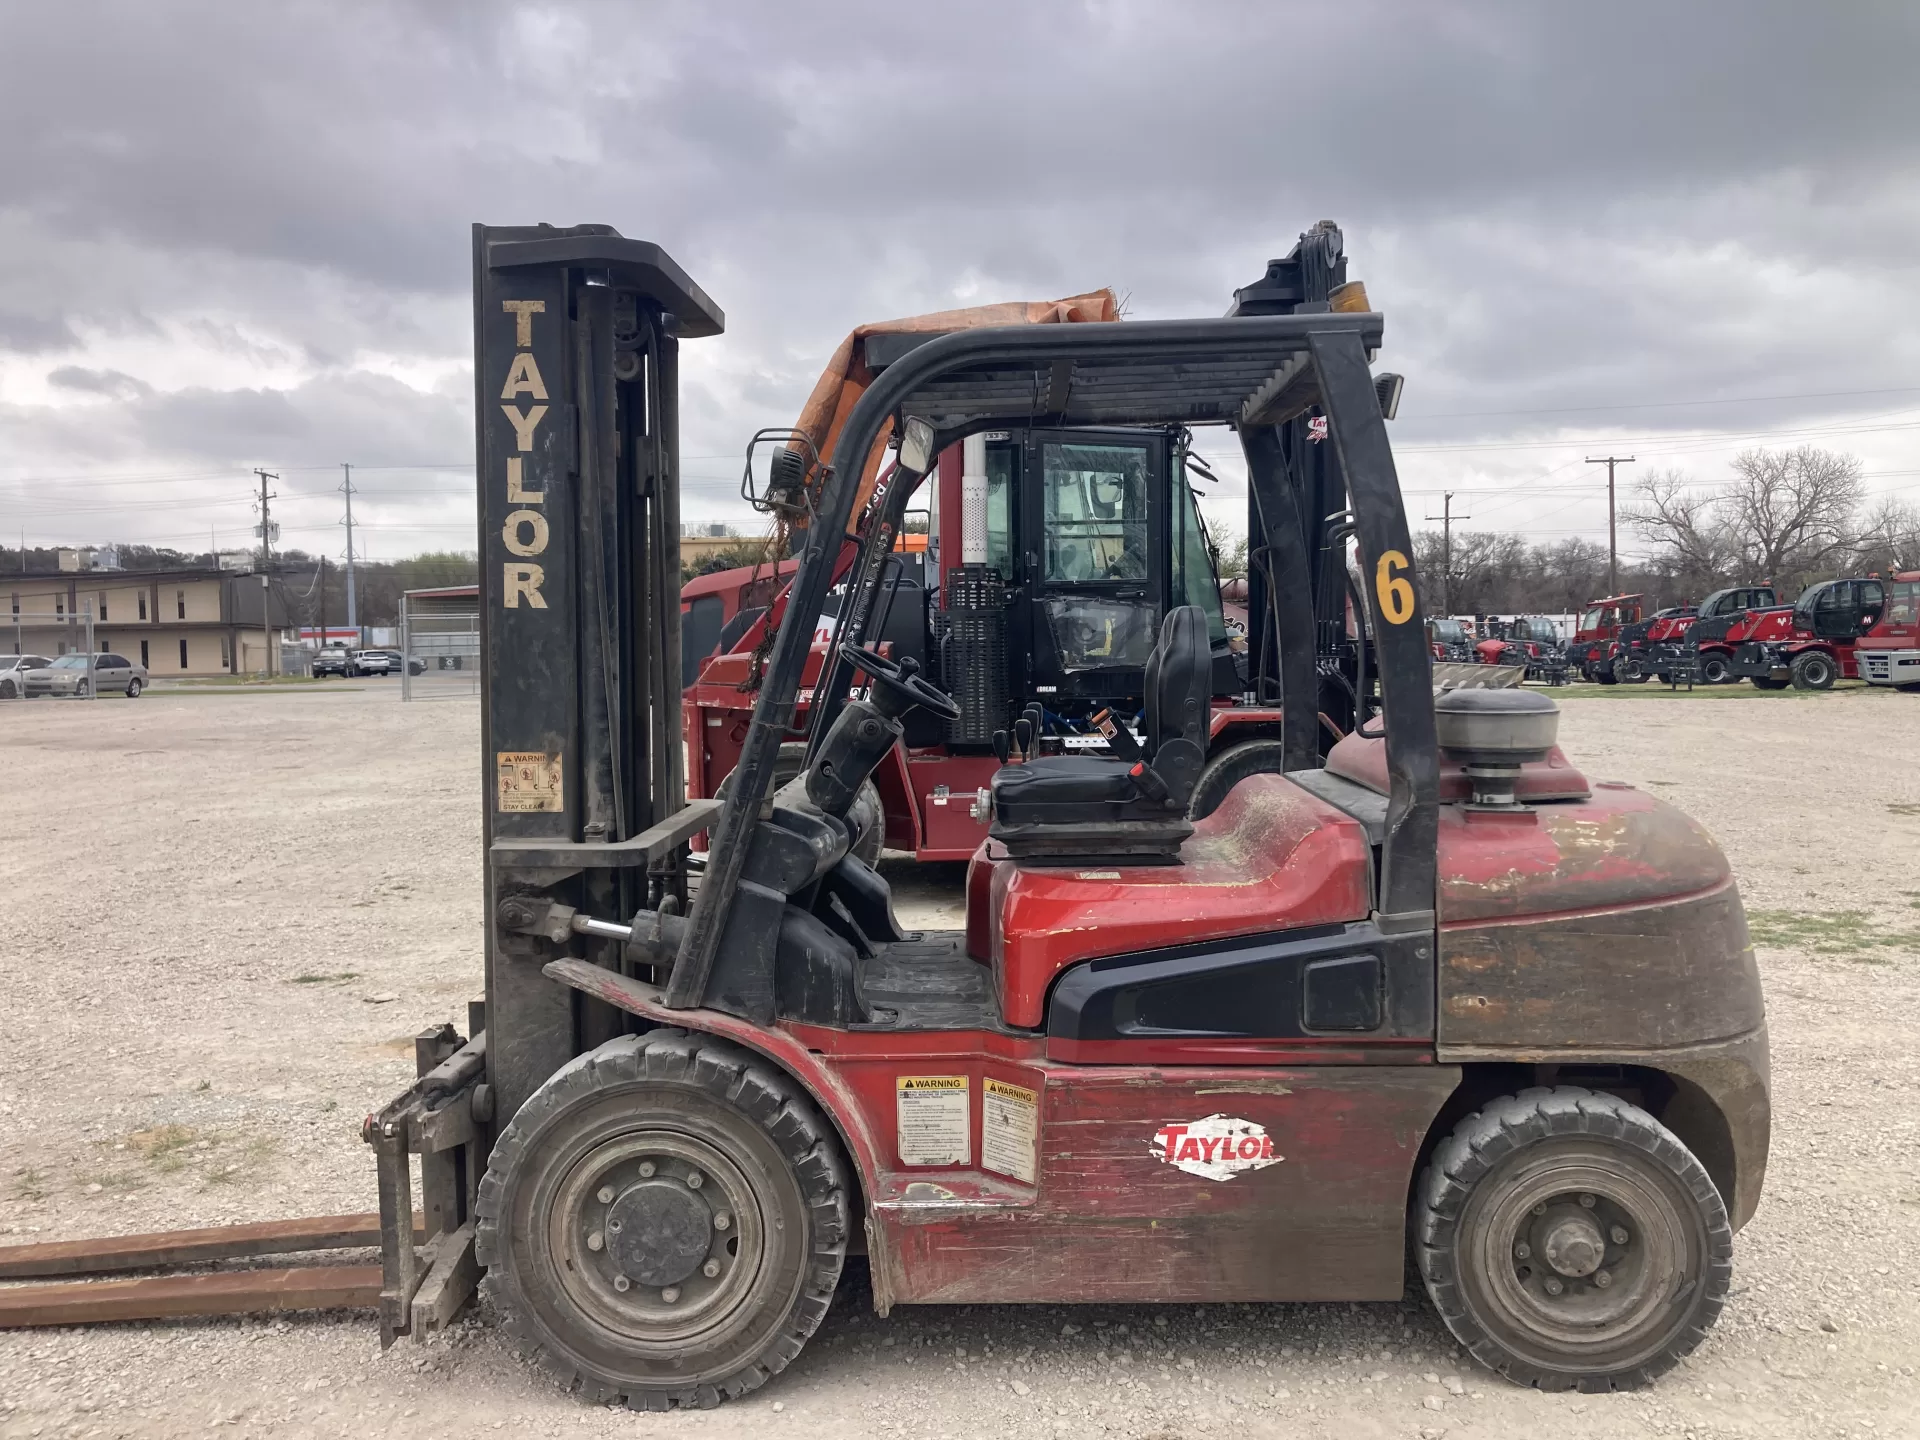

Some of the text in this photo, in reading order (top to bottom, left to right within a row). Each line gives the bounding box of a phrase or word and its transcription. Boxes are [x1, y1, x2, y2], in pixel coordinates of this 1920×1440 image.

[500, 300, 549, 609] TAYLOR
[1376, 550, 1415, 625] 6
[915, 1079, 961, 1088] WARNING
[997, 1085, 1032, 1102] WARNING
